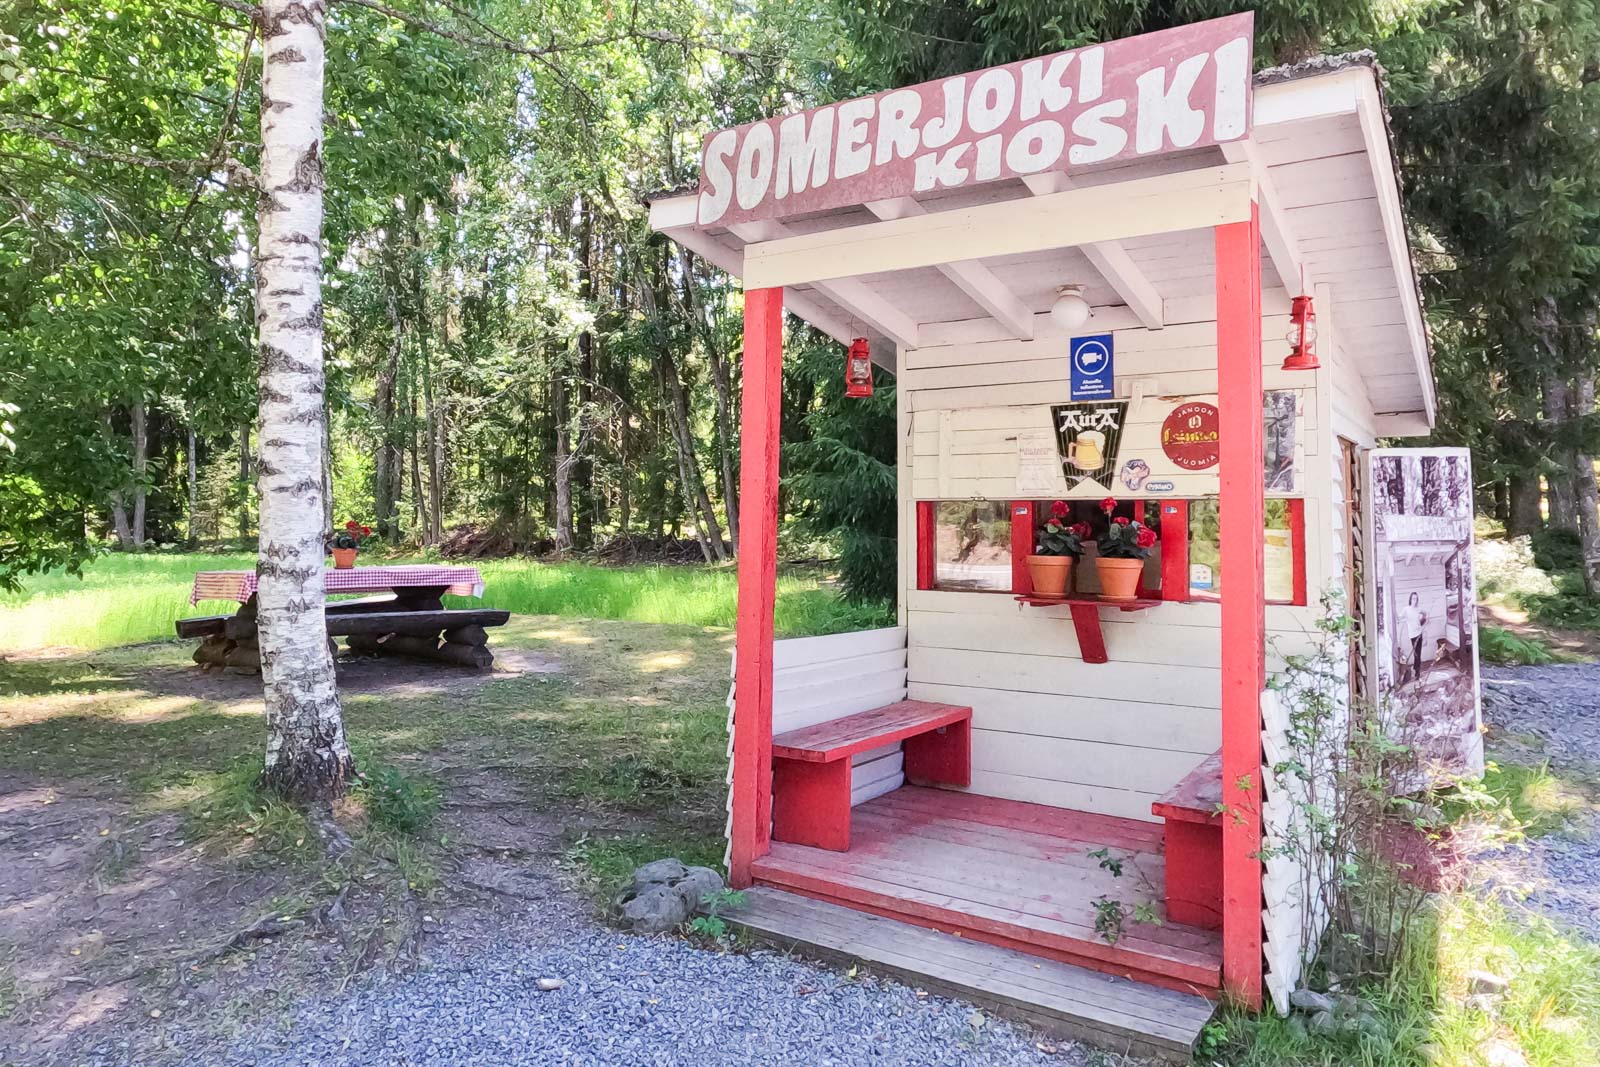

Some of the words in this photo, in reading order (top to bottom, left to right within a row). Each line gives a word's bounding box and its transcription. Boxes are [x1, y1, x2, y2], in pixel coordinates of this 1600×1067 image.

[914, 37, 1249, 192] KIOSKI
[1177, 406, 1214, 418] JANOON
[1177, 455, 1217, 466] JUOMIA
